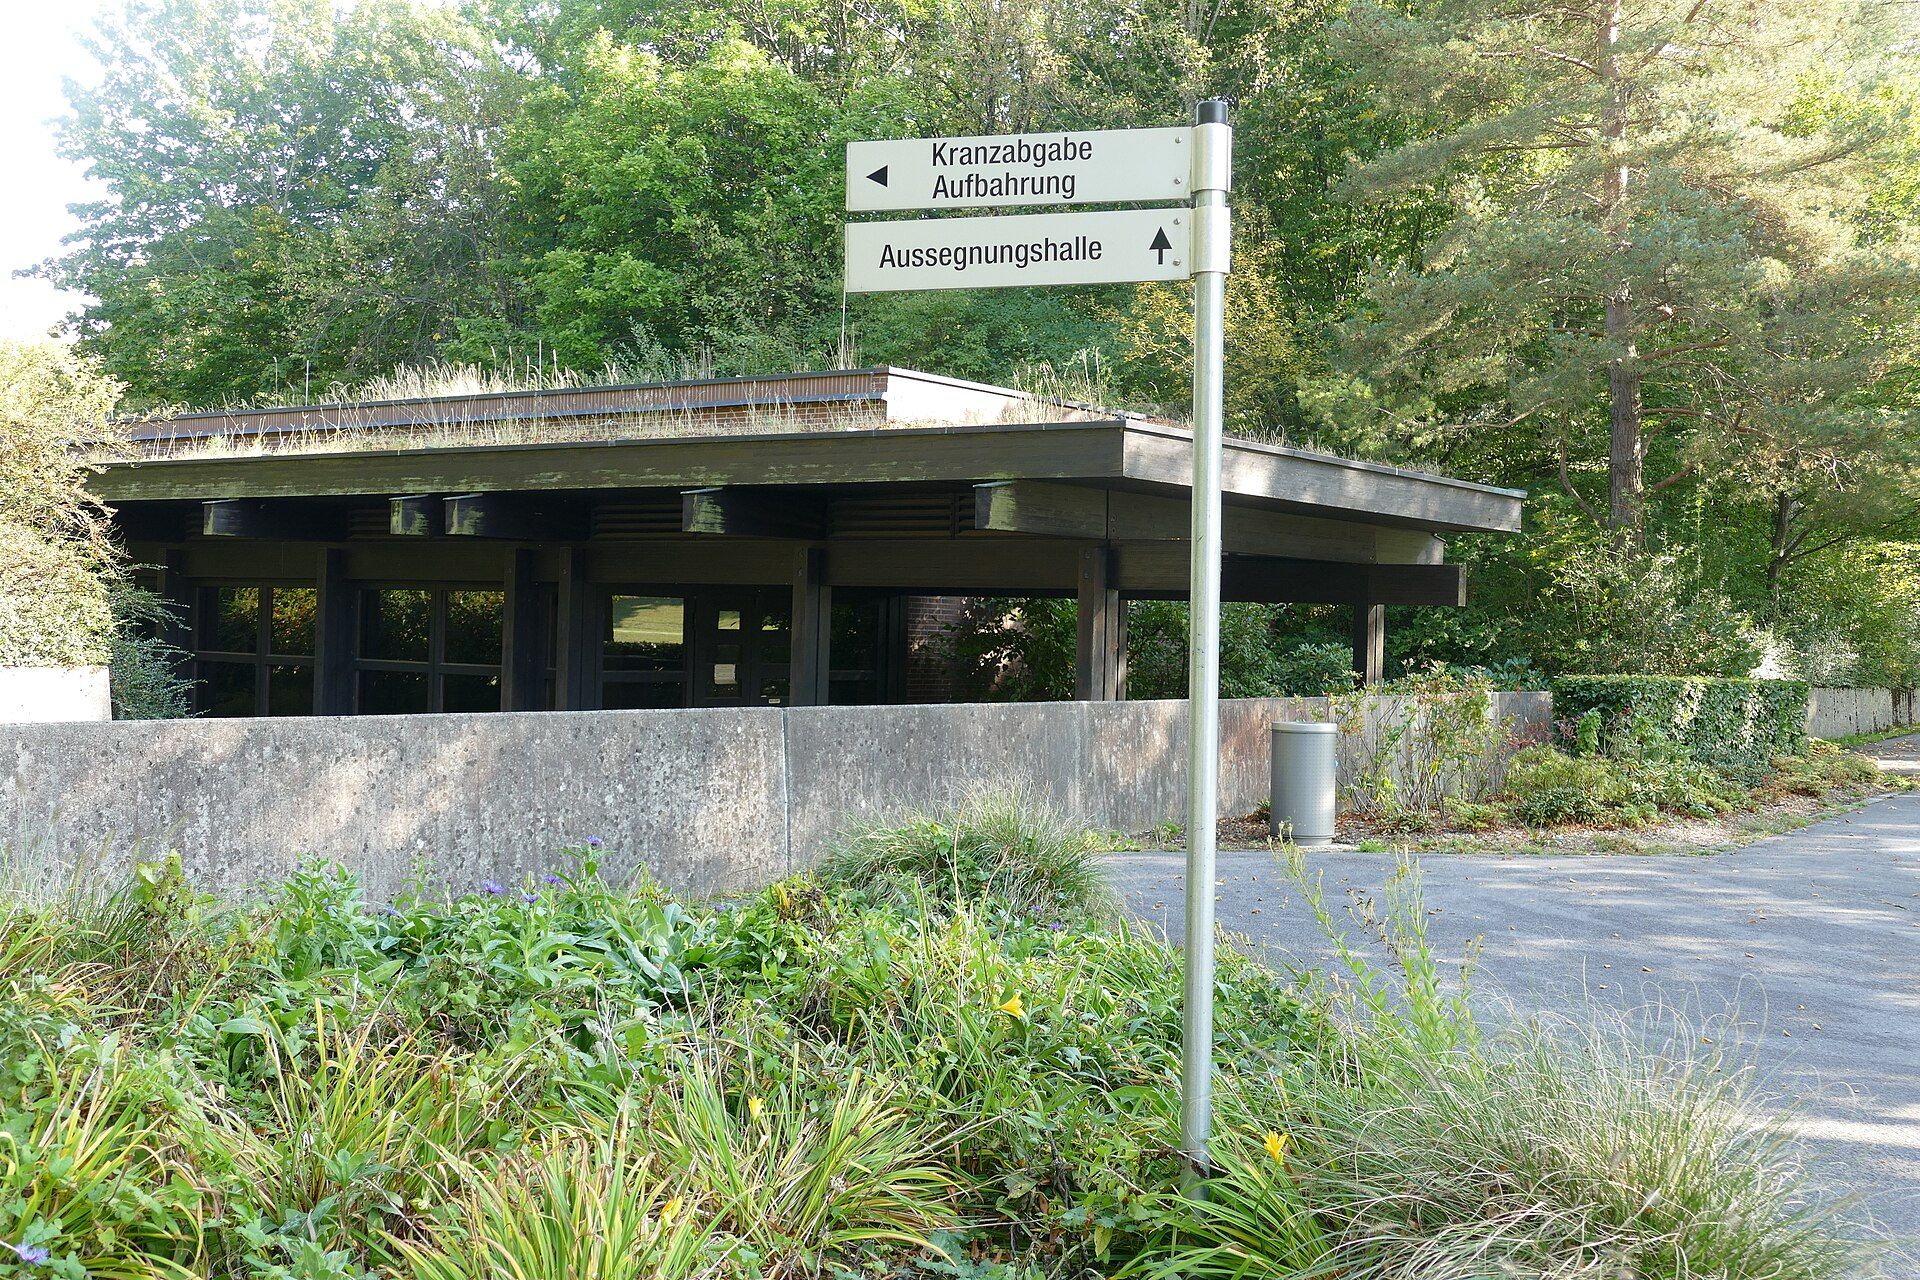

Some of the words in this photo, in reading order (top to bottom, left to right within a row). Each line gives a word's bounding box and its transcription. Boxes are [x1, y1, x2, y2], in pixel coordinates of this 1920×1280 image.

[932, 137, 1093, 168] Kranzabgabe
[932, 172, 1076, 200] Aufbahrung
[879, 236, 1102, 271] Aussegnungshalle
